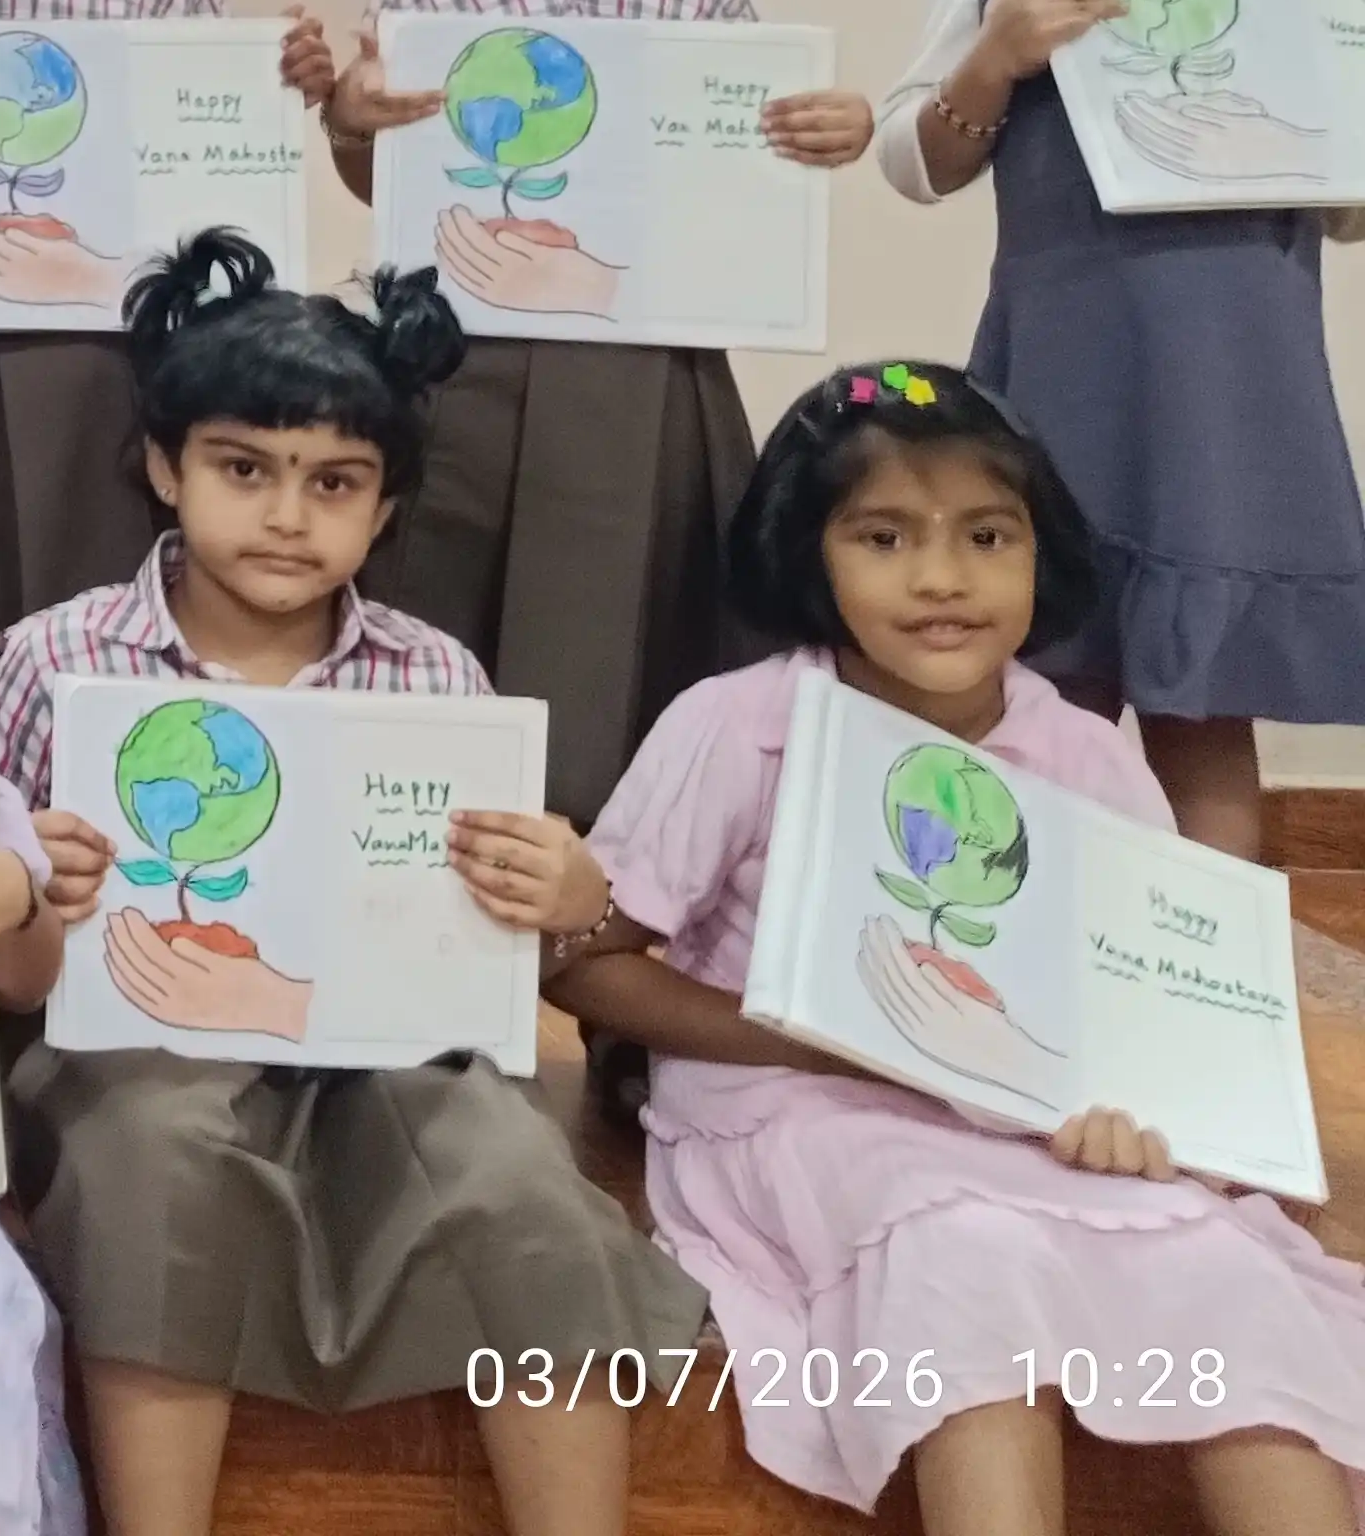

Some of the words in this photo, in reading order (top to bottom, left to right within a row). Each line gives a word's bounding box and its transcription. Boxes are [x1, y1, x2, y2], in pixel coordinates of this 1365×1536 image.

[177, 88, 242, 113] Happy
[704, 75, 770, 104] Happy
[135, 143, 191, 163] Vana
[363, 772, 450, 807] Happy
[1147, 884, 1219, 937] Happy
